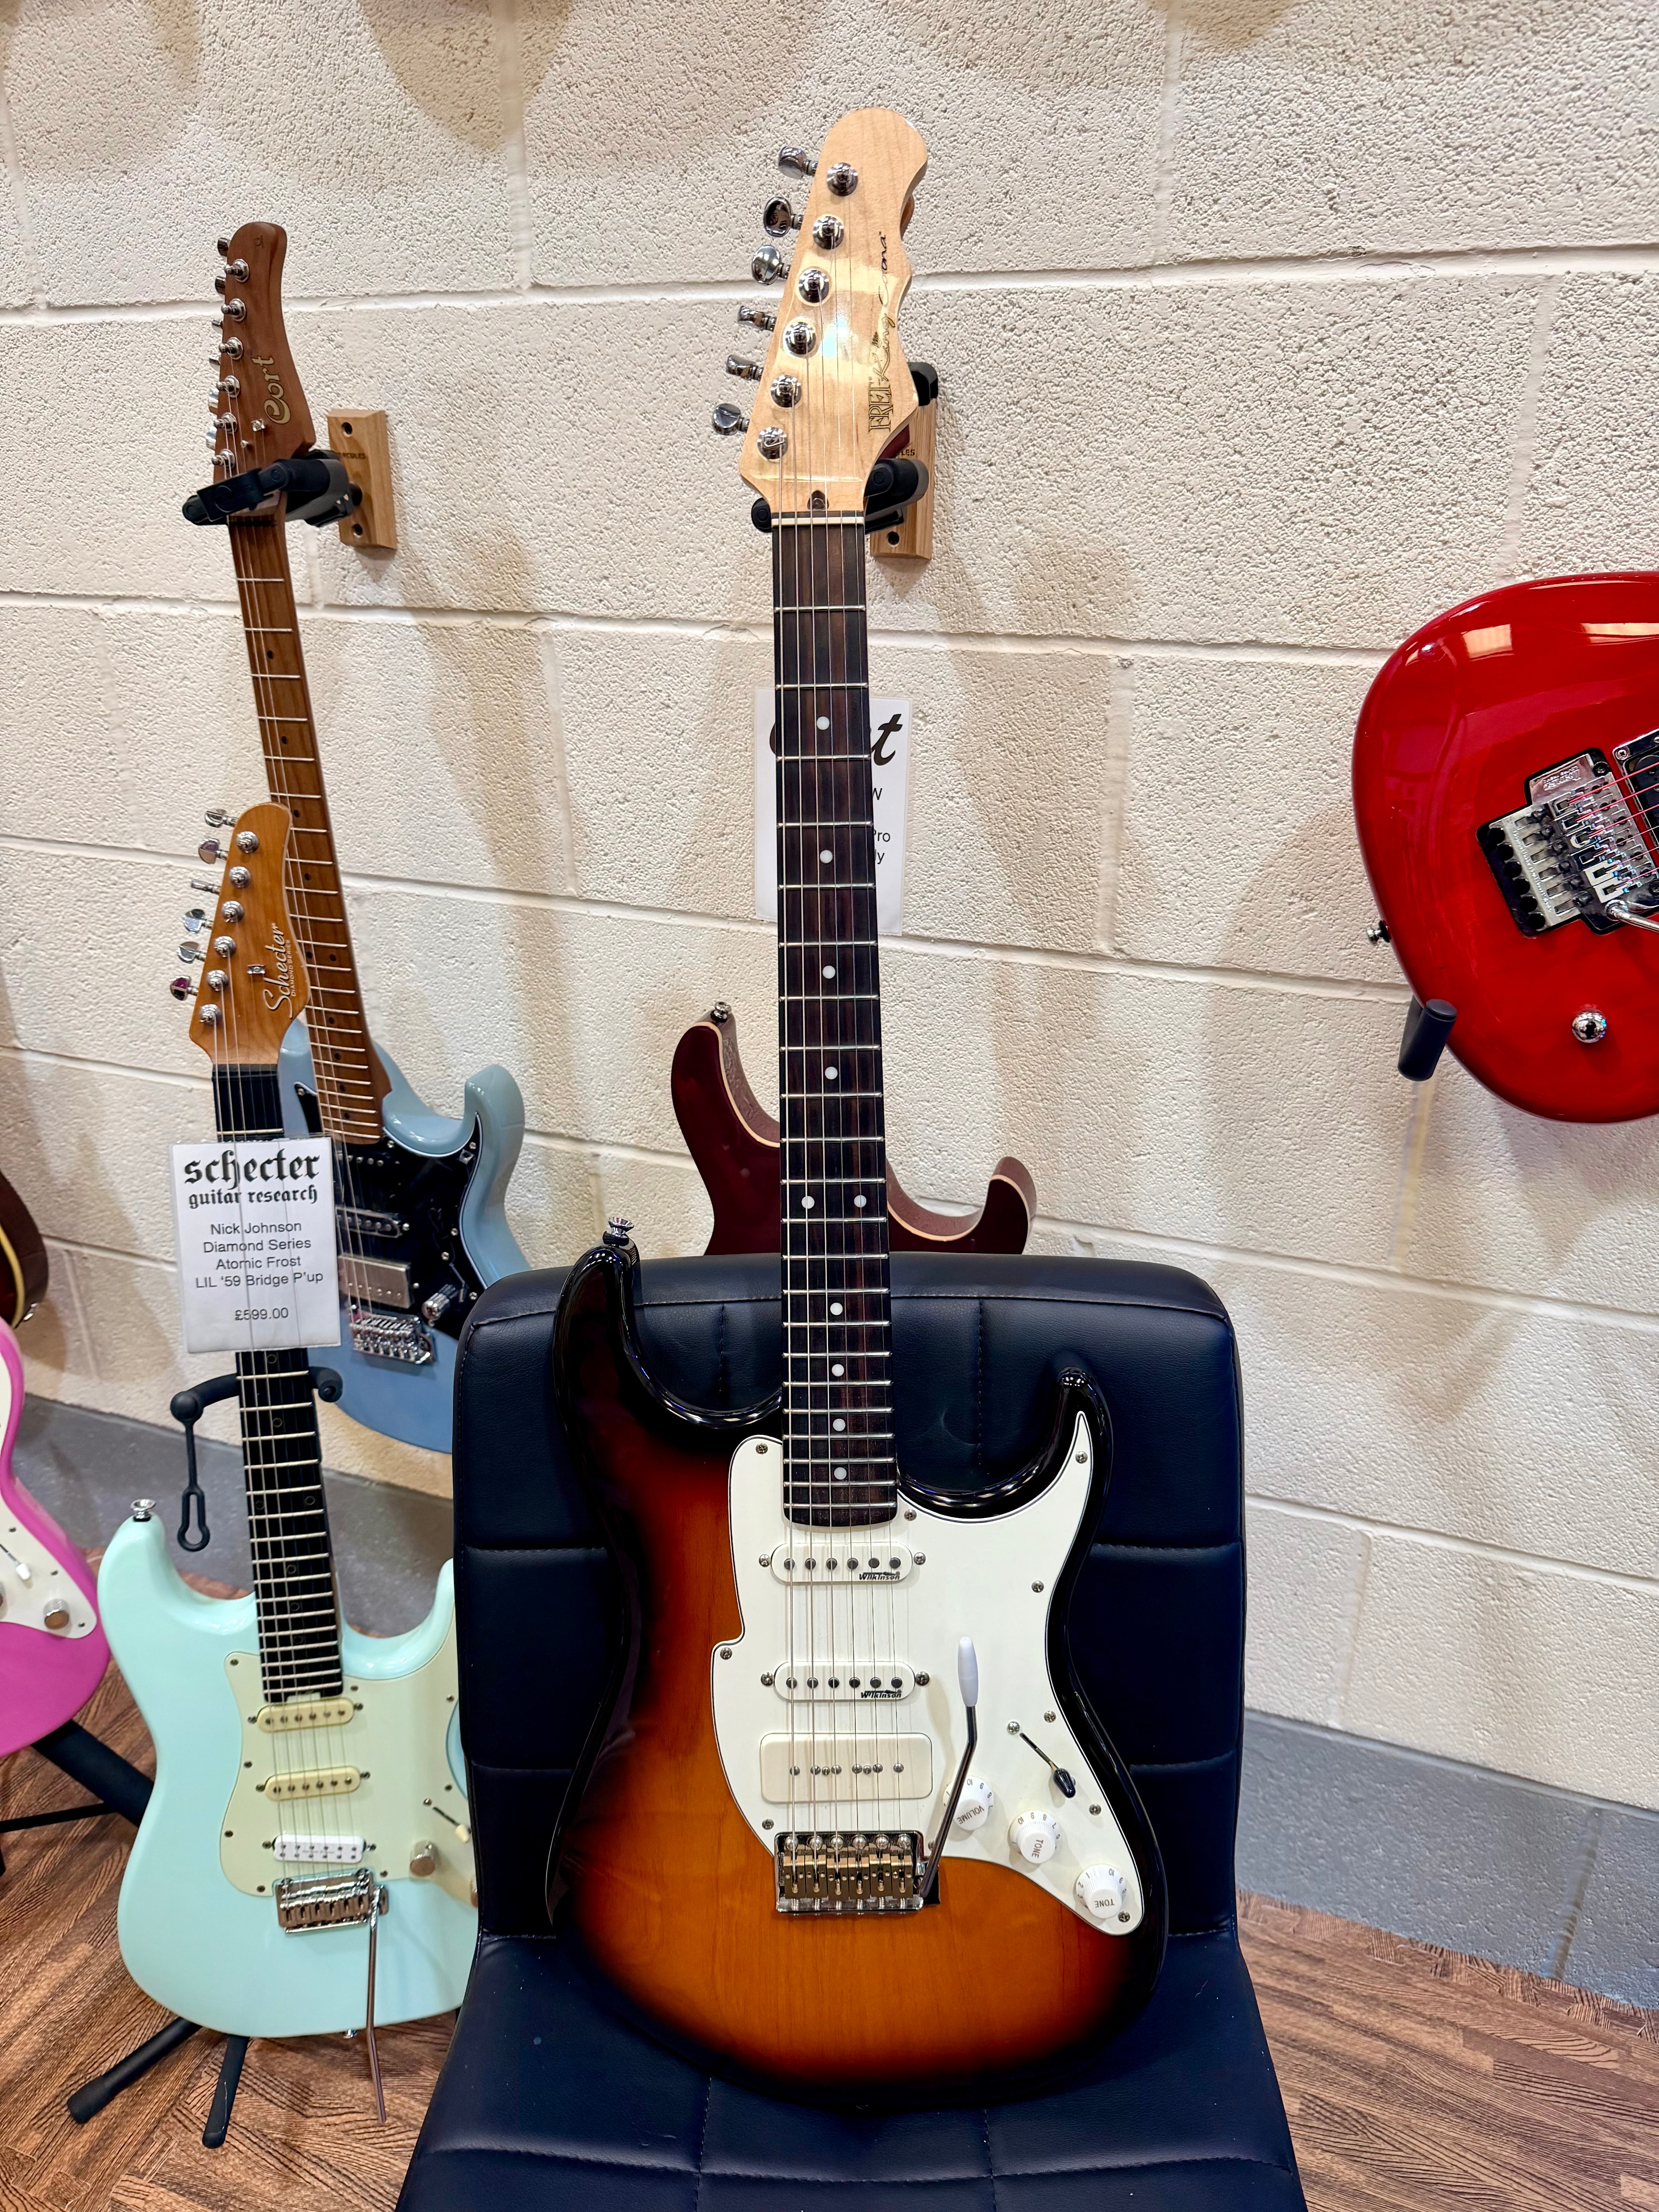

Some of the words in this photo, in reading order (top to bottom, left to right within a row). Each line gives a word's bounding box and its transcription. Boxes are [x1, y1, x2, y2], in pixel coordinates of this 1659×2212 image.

[252, 355, 290, 424] Cort
[263, 925, 292, 1018] Schecter
[184, 1148, 320, 1190] schecter
[189, 1188, 242, 1209] guitar
[248, 1184, 318, 1204] research
[211, 1223, 240, 1235] Nick
[244, 1223, 302, 1233] Johnson
[203, 1240, 263, 1253] Diamond
[269, 1238, 311, 1250] Series
[216, 1258, 262, 1270] Atomic
[267, 1256, 301, 1268] Frost
[196, 1277, 217, 1288] LIL
[246, 1274, 289, 1287] Bridge
[235, 1307, 289, 1321] £599.00
[957, 1805, 985, 1824] VOLUME
[1032, 1839, 1044, 1858] TONE
[1094, 1899, 1115, 1908] TONE
